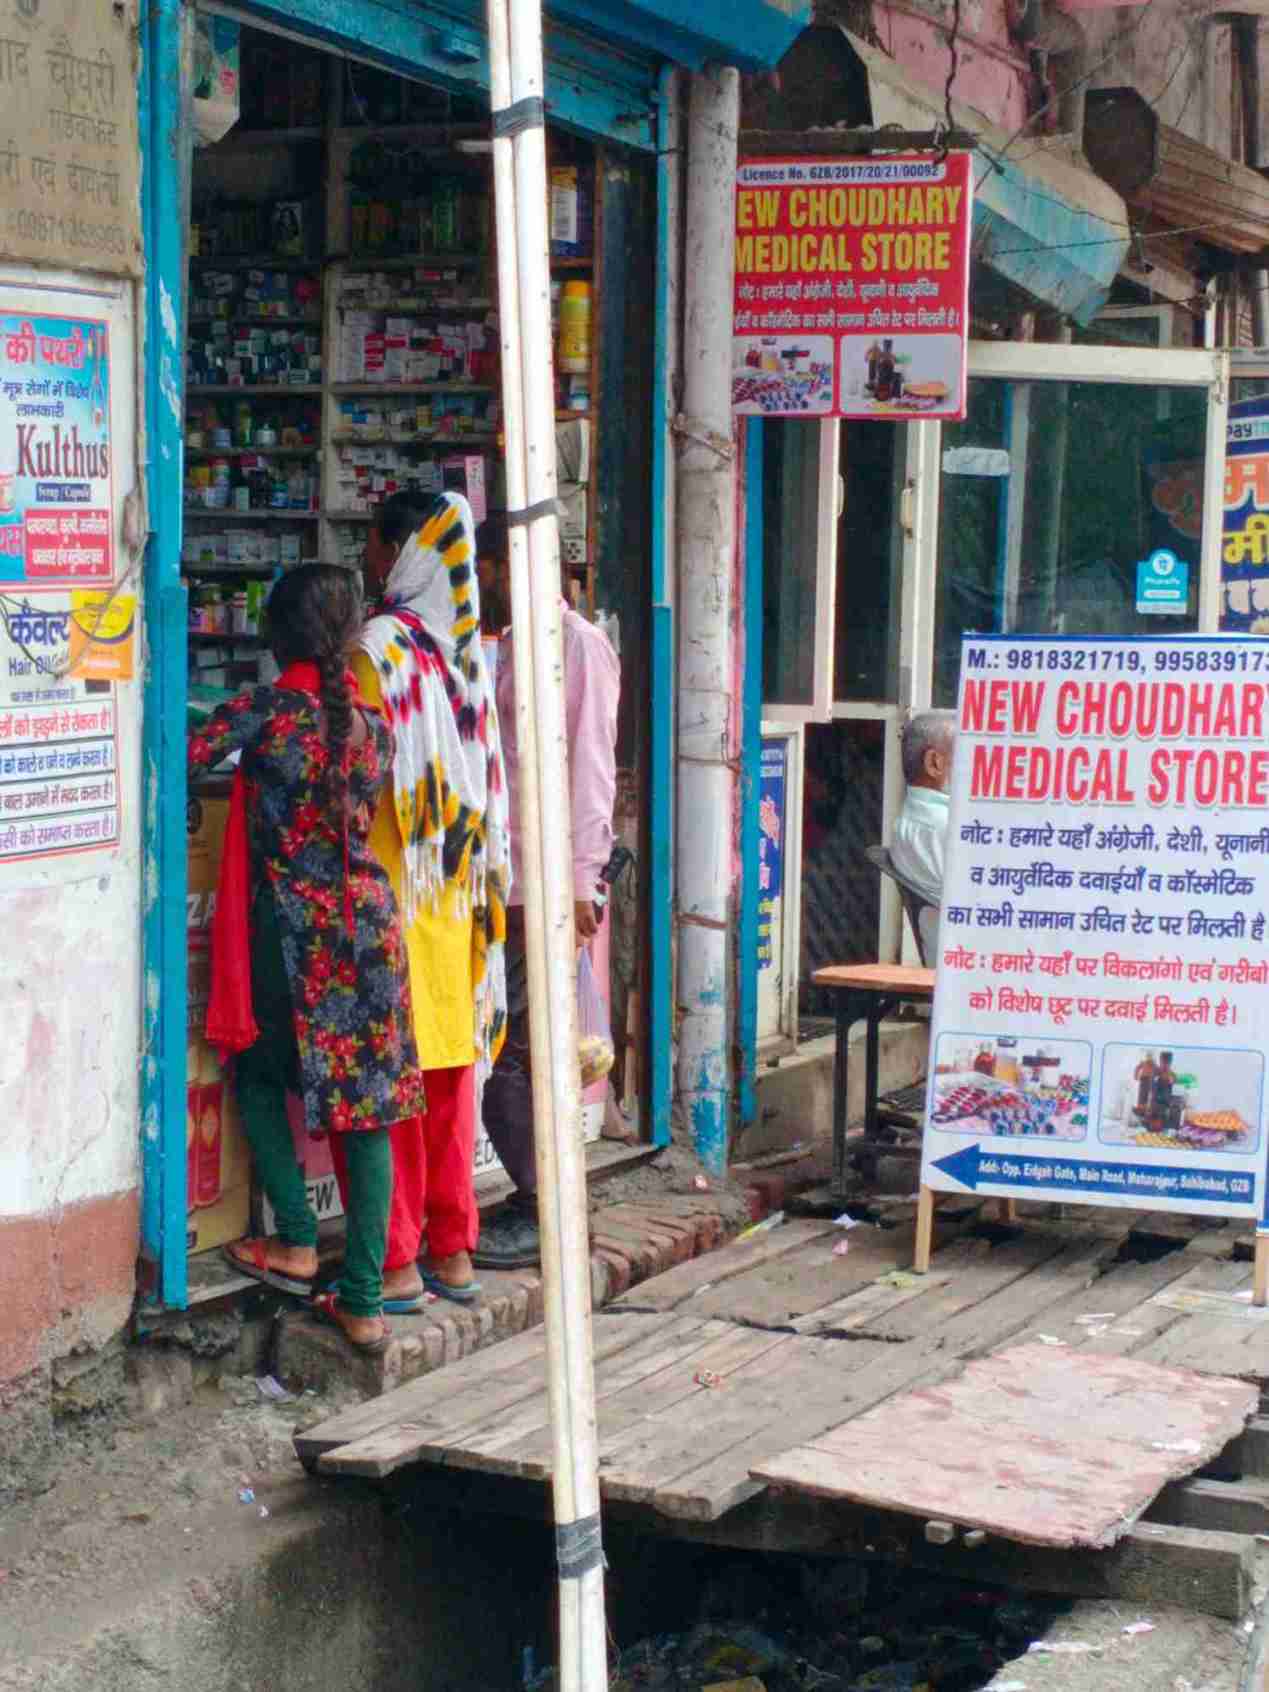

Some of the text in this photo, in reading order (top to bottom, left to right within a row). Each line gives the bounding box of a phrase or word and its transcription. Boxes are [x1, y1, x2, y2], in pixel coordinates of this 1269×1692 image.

[738, 186, 962, 228] EW CHOUDHARY
[736, 231, 951, 273] MEDICAL STORE
[16, 423, 109, 480] Kulthus
[1007, 649, 1147, 674] 9818321719,
[961, 680, 1046, 734] NEW
[970, 745, 1269, 806] MEDICAL STORE
[1009, 823, 1053, 848] हमारे
[1058, 823, 1094, 849] यहाँ
[970, 865, 983, 885] व
[988, 862, 1073, 896] आयुर्वेदिक
[1148, 875, 1161, 894] व
[1167, 867, 1256, 896] कॉस्मेटिक
[947, 905, 972, 926] का
[976, 901, 1012, 928] सभी
[1018, 910, 1074, 931] सामान
[1080, 906, 1125, 933] उचित
[1132, 908, 1154, 934] रेट
[1158, 914, 1182, 936] पर
[1187, 910, 1245, 939] मिलती
[991, 948, 1034, 974] हमारे
[1039, 950, 1073, 976] यहाँ
[1076, 957, 1098, 976] पर
[1188, 957, 1216, 982] एवं
[969, 986, 994, 1012] को
[998, 986, 1042, 1015] विशेष
[1048, 995, 1073, 1026] छूट
[1077, 998, 1100, 1018] पर
[1104, 993, 1149, 1023] दवाई
[1154, 996, 1209, 1025] मिलती
